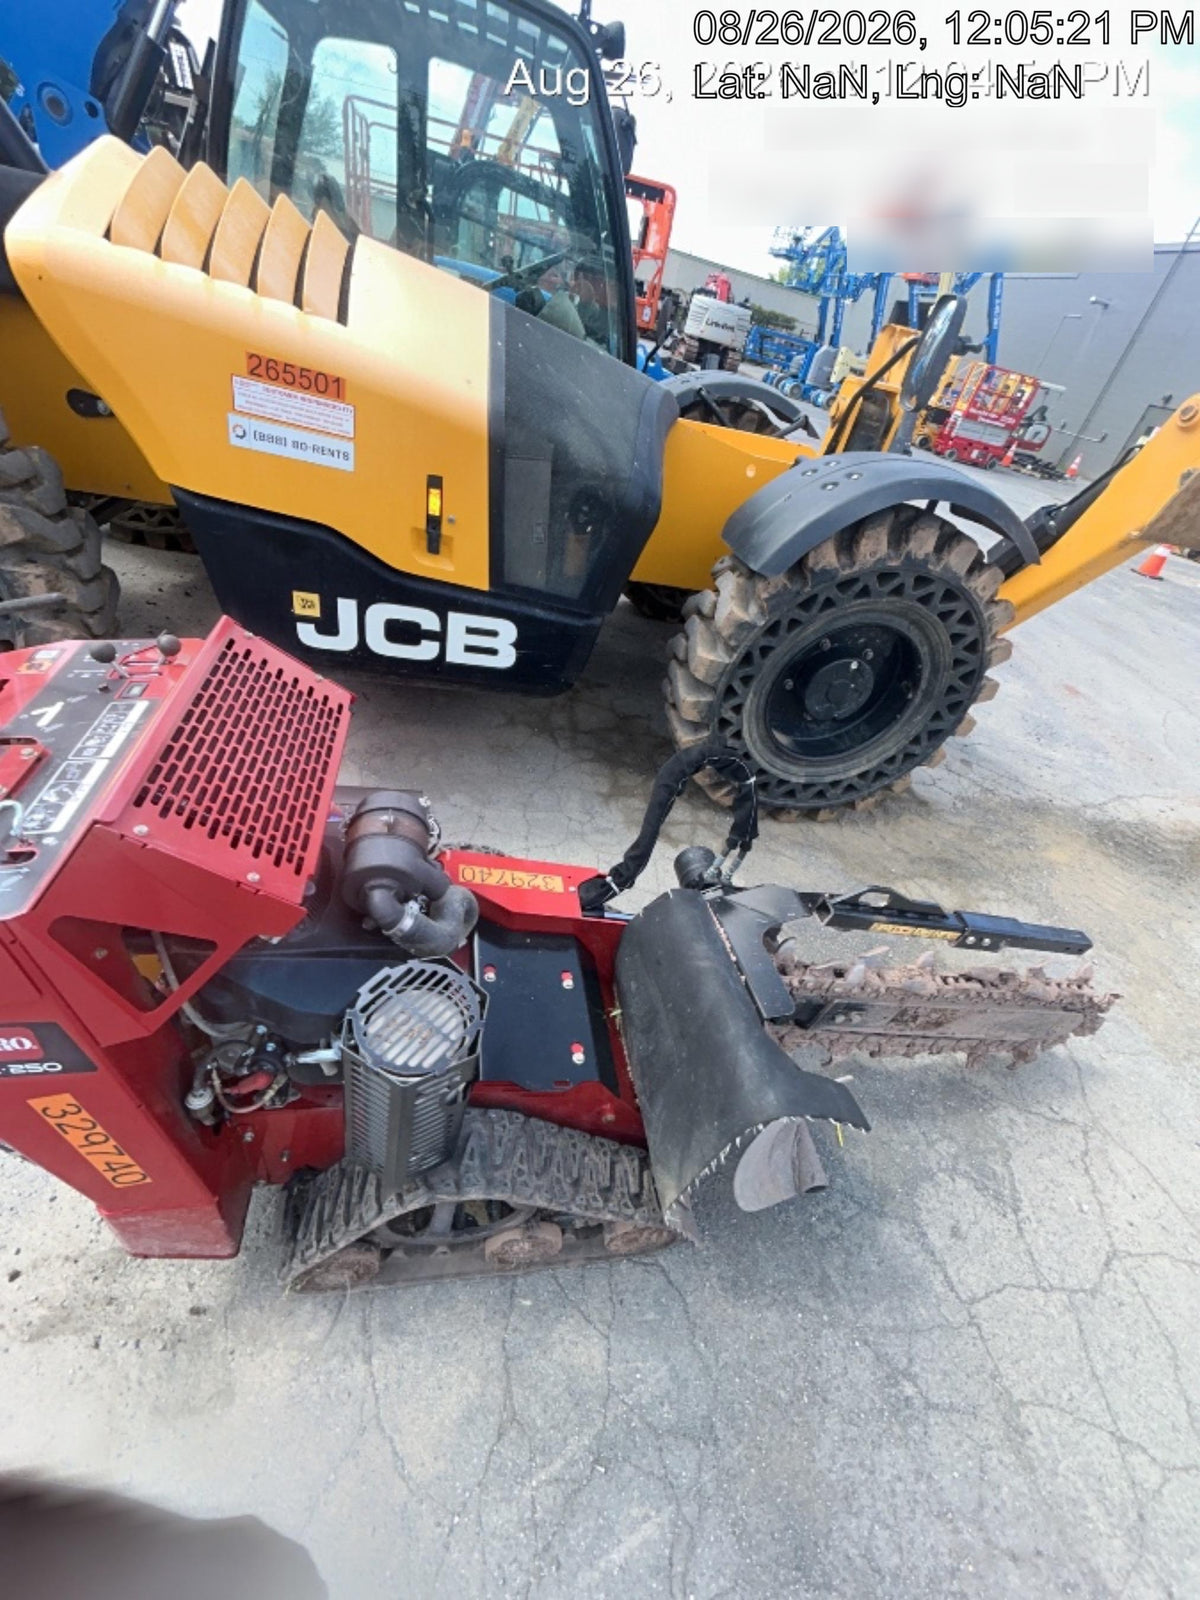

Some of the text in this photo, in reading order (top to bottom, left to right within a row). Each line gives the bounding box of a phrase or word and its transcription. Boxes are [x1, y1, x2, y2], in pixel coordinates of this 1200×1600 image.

[248, 353, 343, 399] 265501
[296, 597, 518, 669] JCB
[460, 866, 557, 893] 329740
[41, 1103, 147, 1186] 329740
